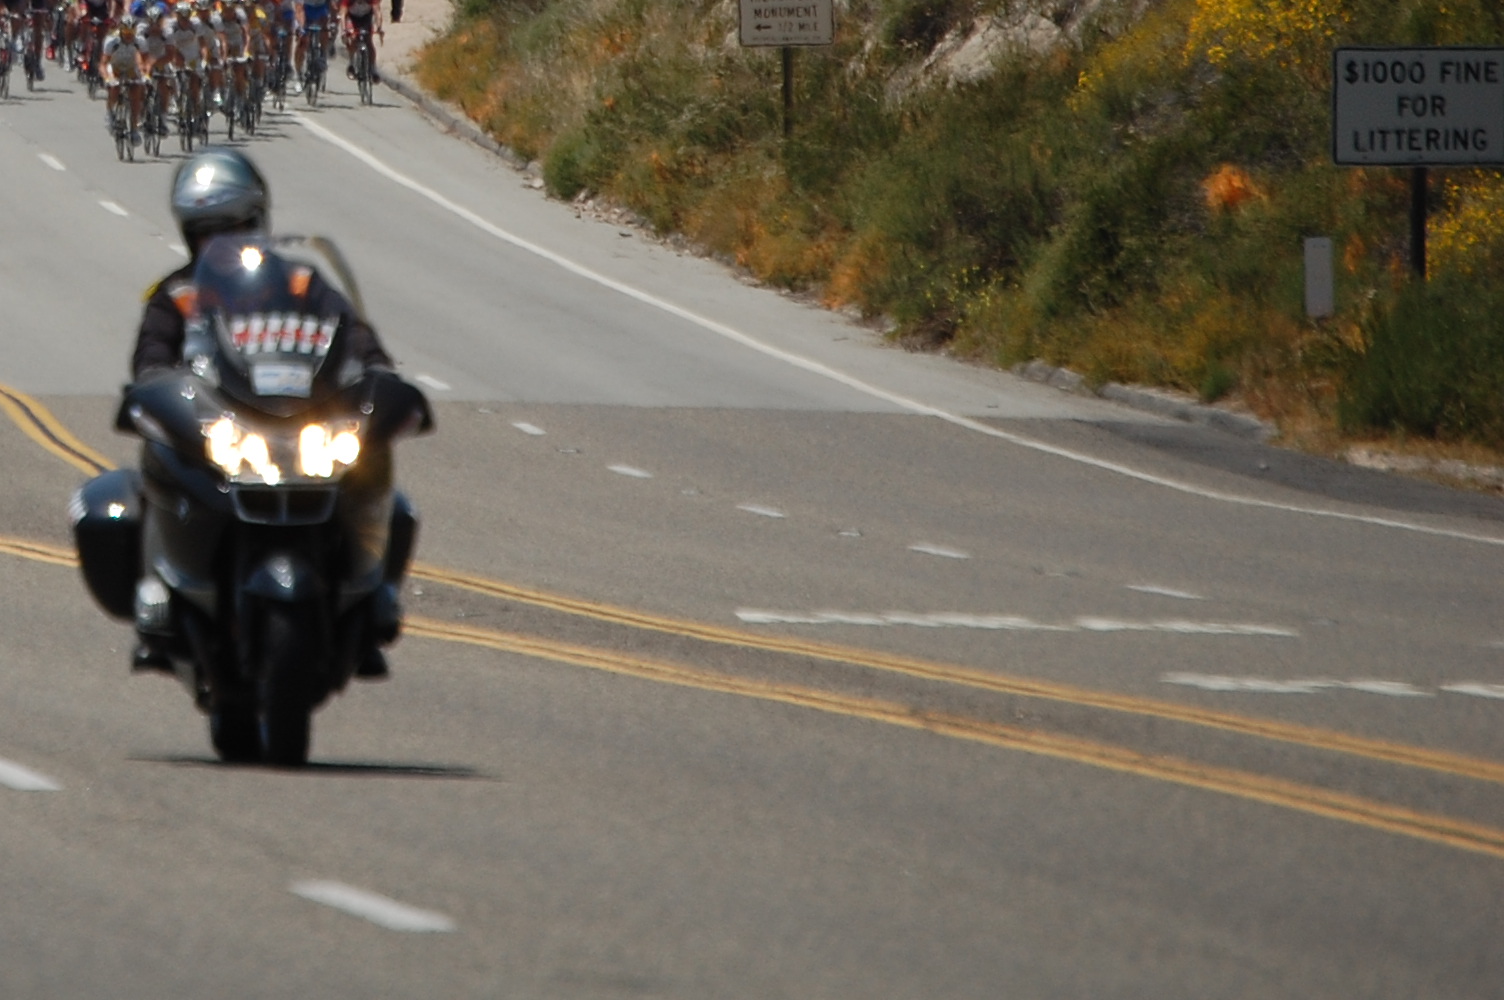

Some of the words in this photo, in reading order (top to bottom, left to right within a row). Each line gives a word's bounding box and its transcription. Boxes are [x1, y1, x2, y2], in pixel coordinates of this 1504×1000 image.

[754, 5, 818, 18] MONUMENT
[1345, 61, 1425, 84] $1000
[1440, 61, 1499, 83] FINE
[1397, 96, 1445, 117] FOR
[1353, 129, 1488, 152] LITTERING
